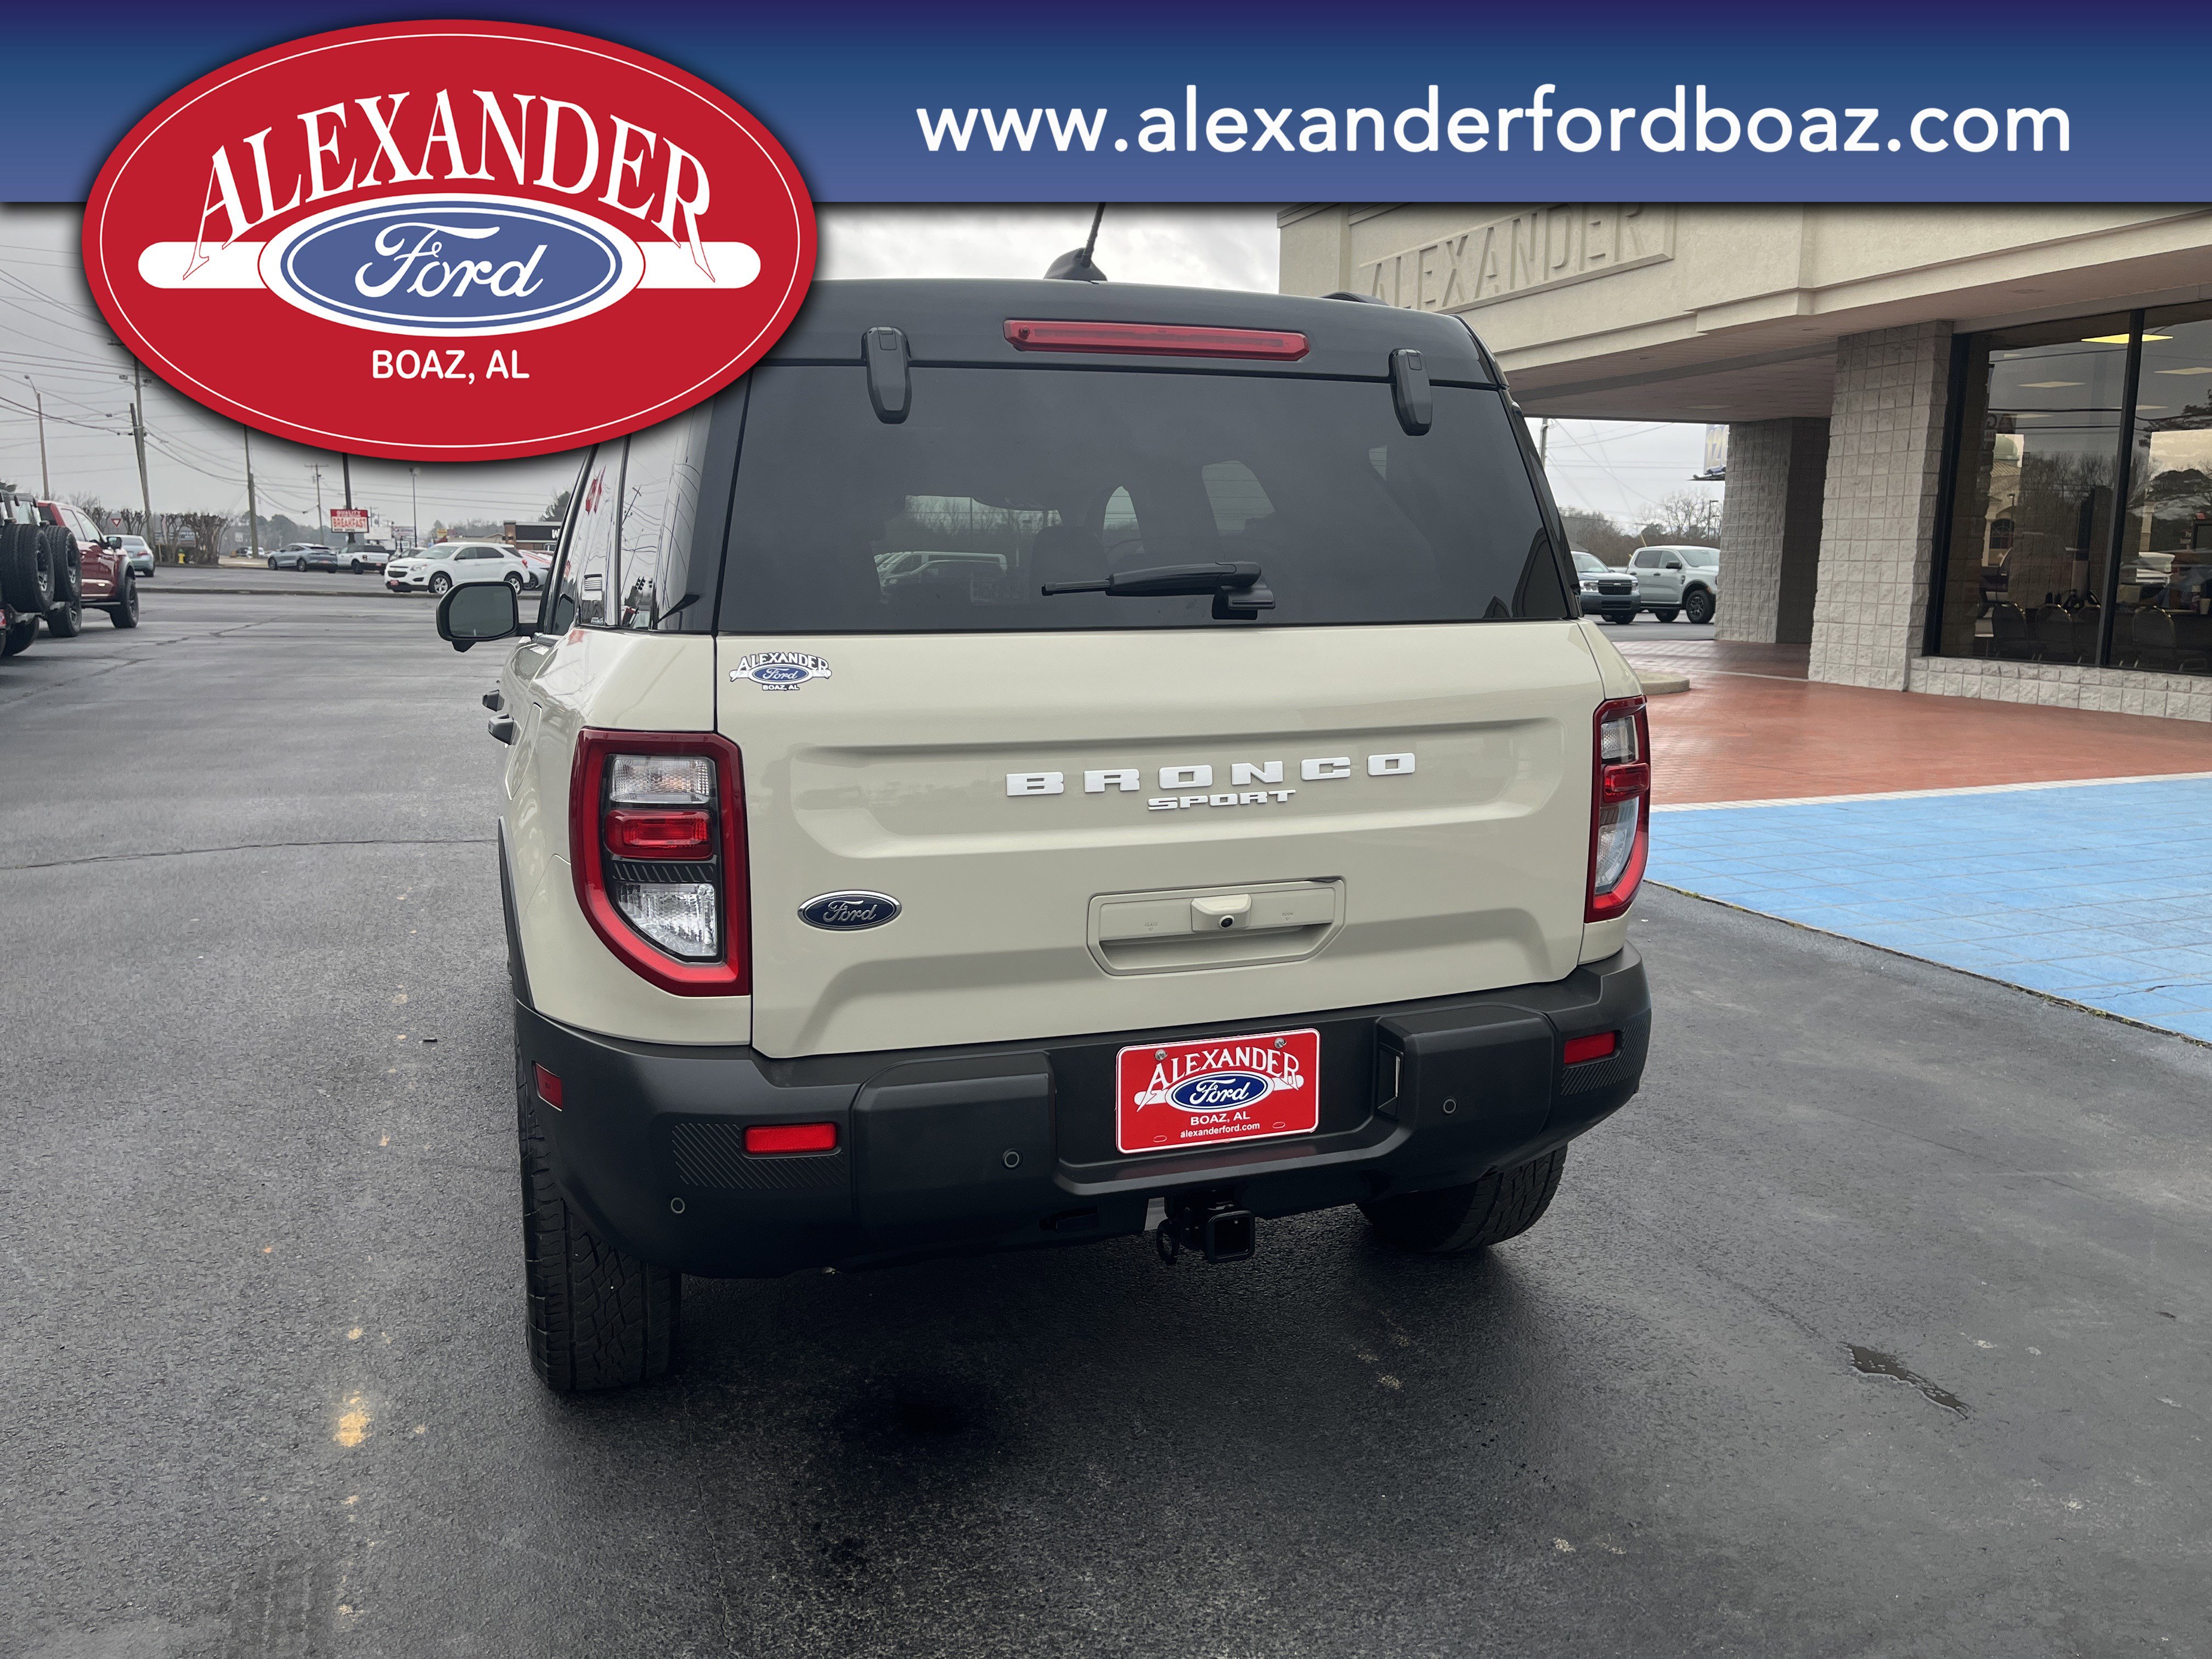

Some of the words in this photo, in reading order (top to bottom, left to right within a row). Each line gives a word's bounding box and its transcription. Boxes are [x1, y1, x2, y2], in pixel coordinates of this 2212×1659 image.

[1371, 202, 1646, 310] ALEXANDER
[333, 518, 366, 528] BREAKFAST
[731, 652, 829, 682] ALEXANDER
[762, 667, 798, 680] Ford
[1006, 752, 1416, 797] BRONCO
[1147, 789, 1296, 811] SPORT
[822, 900, 877, 922] Ford
[1136, 1046, 1299, 1113] ALEXANDER
[1189, 1078, 1250, 1105] Ford
[1190, 1113, 1230, 1126] BOAZ,
[1233, 1111, 1250, 1121] AL
[1180, 1121, 1261, 1139] alexanderford.com
